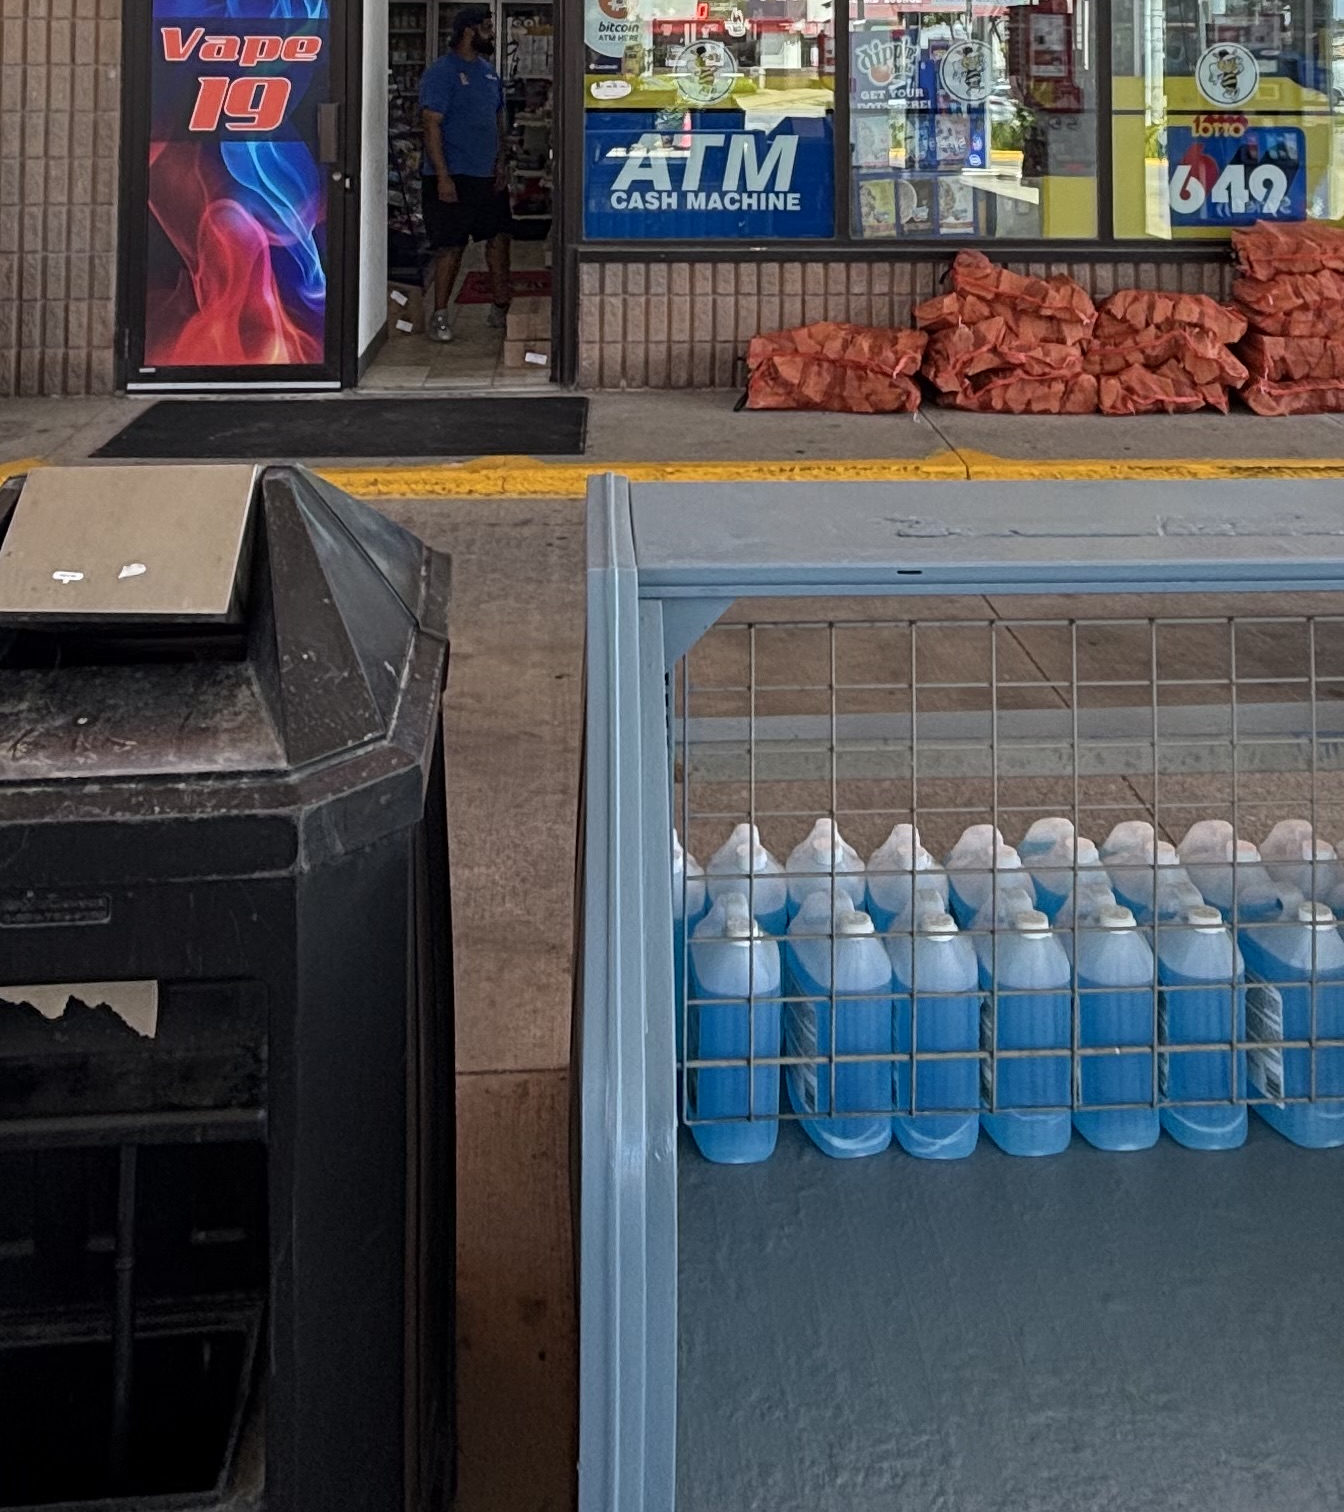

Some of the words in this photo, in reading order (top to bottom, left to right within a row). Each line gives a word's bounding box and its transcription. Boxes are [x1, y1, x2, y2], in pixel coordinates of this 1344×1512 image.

[160, 27, 322, 66] Vape
[598, 21, 640, 33] bitcoin
[189, 76, 292, 131] 19
[860, 90, 886, 100] GET
[887, 88, 924, 98] YOUR
[610, 133, 799, 192] ATM
[610, 191, 678, 210] CASH
[686, 192, 801, 212] MACHINE
[1169, 164, 1288, 214] 649
